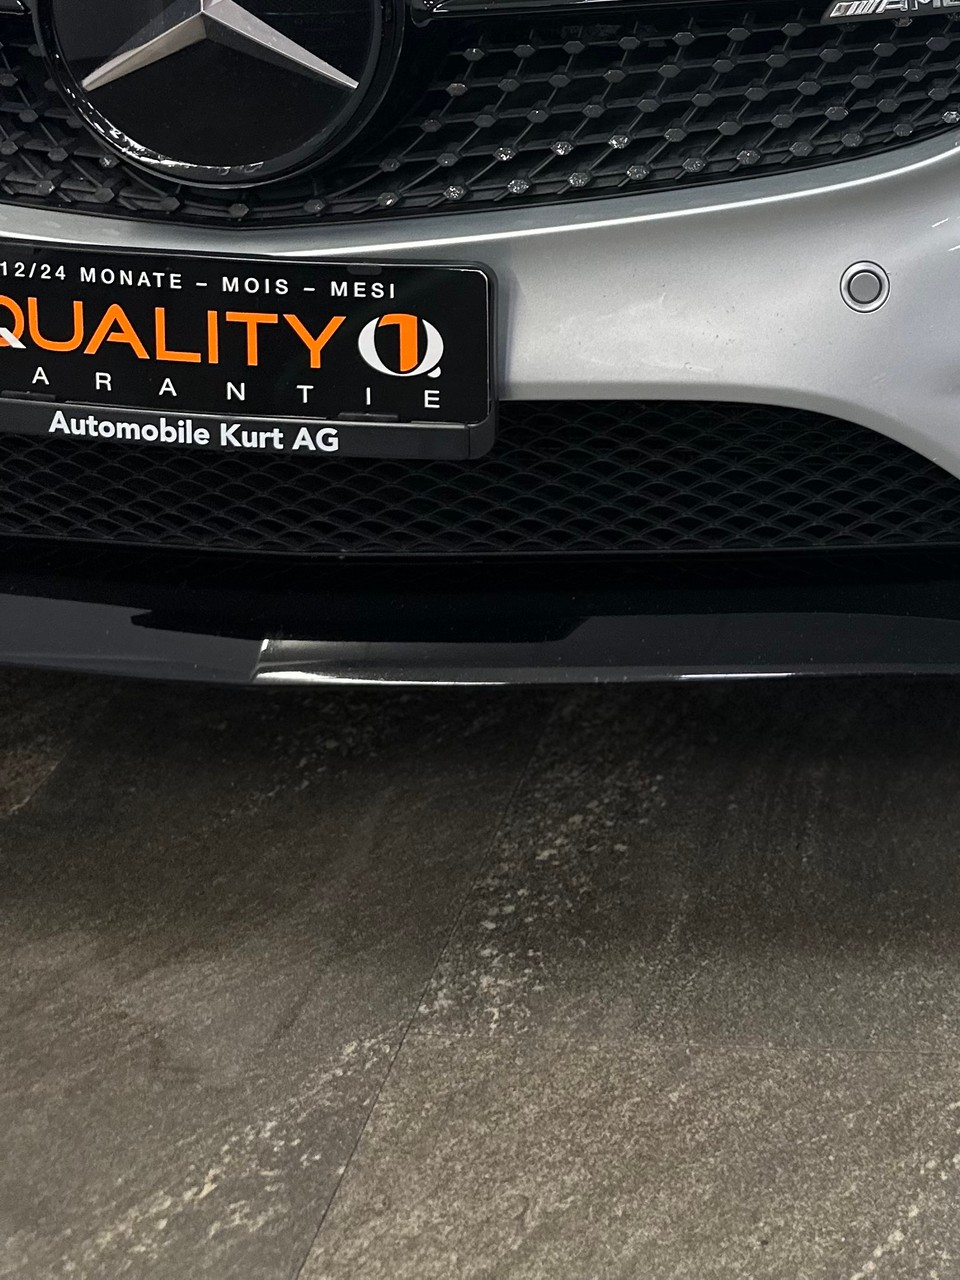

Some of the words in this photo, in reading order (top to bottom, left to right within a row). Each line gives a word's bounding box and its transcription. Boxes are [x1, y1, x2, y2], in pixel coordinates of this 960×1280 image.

[0, 261, 66, 280] 12/24
[80, 267, 182, 289] MONATE
[222, 277, 289, 295] MOIS
[330, 281, 395, 299] MESI
[49, 410, 210, 445] Automobile
[220, 423, 284, 450] Kurt
[292, 427, 339, 452] AG
